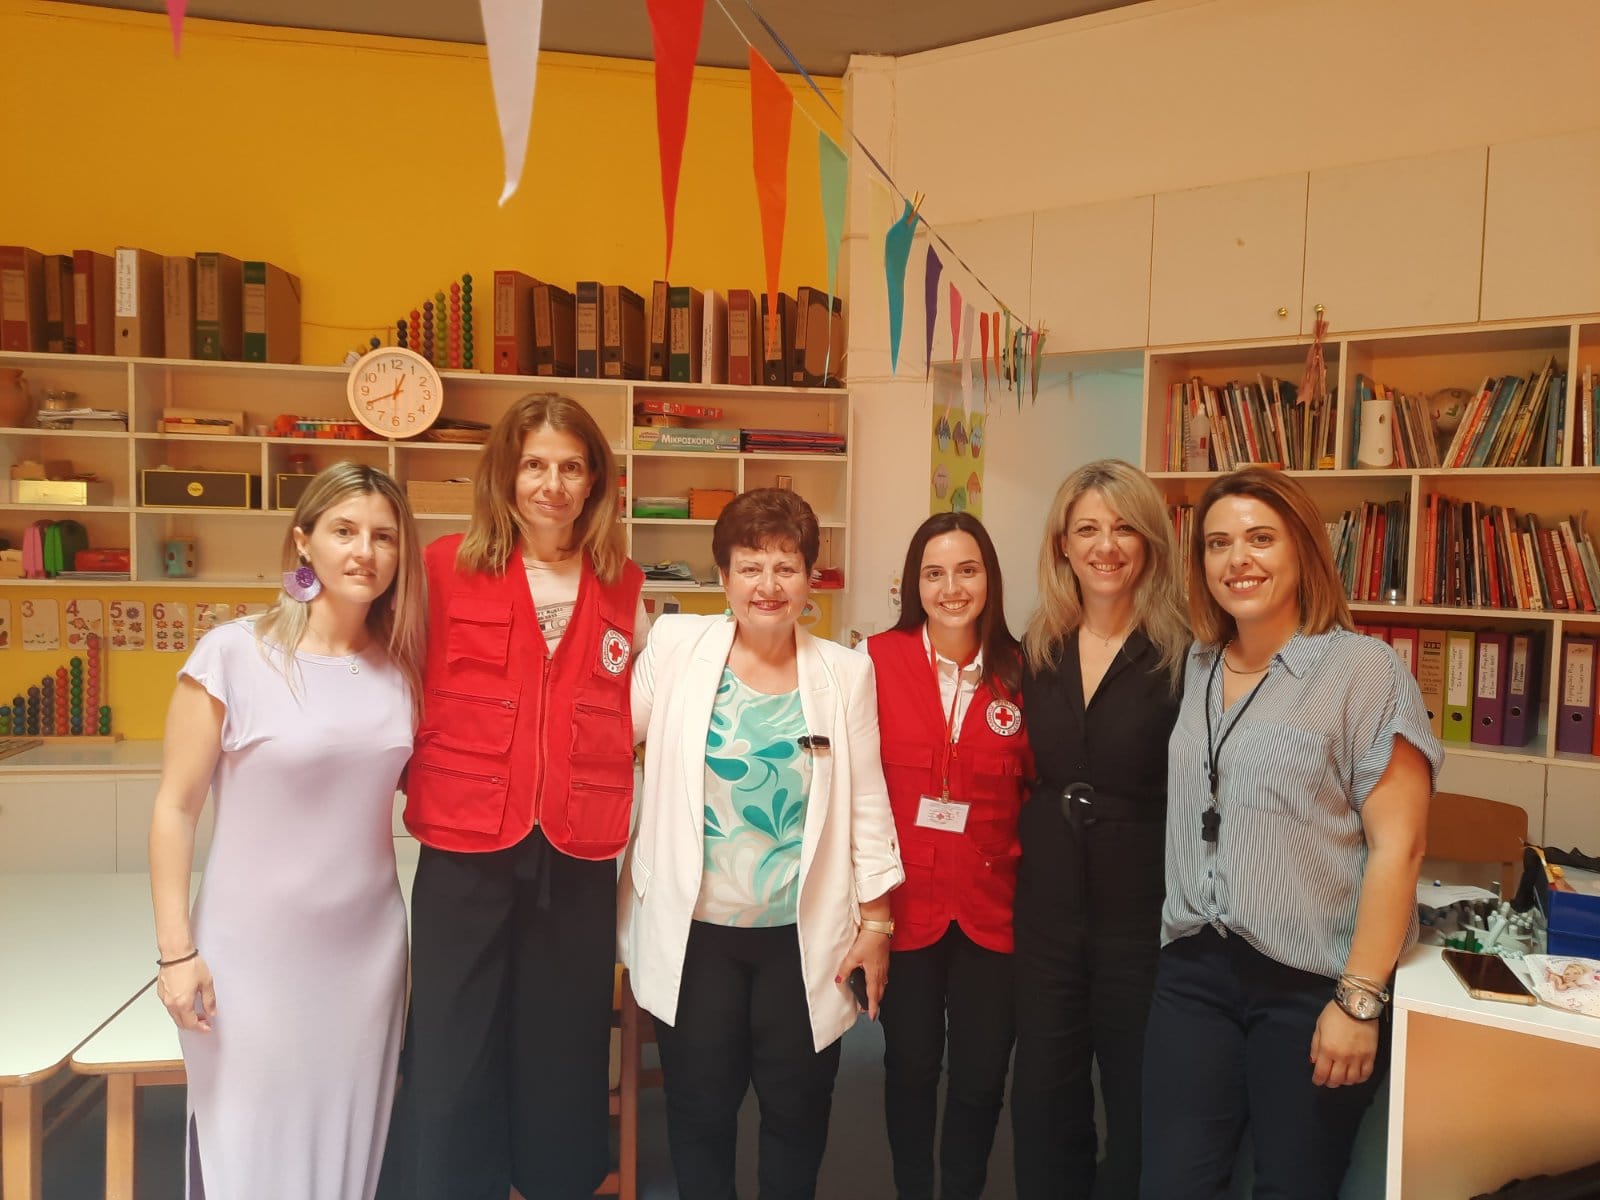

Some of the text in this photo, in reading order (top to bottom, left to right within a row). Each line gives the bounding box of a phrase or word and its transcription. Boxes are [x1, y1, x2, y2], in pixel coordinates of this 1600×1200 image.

[377, 363, 386, 373] 11
[391, 359, 403, 370] 12
[365, 373, 377, 383] 10
[419, 377, 428, 387] 2
[361, 385, 370, 396] 9
[423, 390, 432, 401] 3
[377, 410, 385, 421] 7
[418, 405, 426, 415] 4
[392, 416, 400, 426] 6
[408, 413, 416, 423] 5
[22, 600, 35, 618] 3
[66, 600, 80, 617] 4
[110, 601, 123, 619] 5
[152, 603, 165, 620] 6
[197, 604, 209, 622] 7
